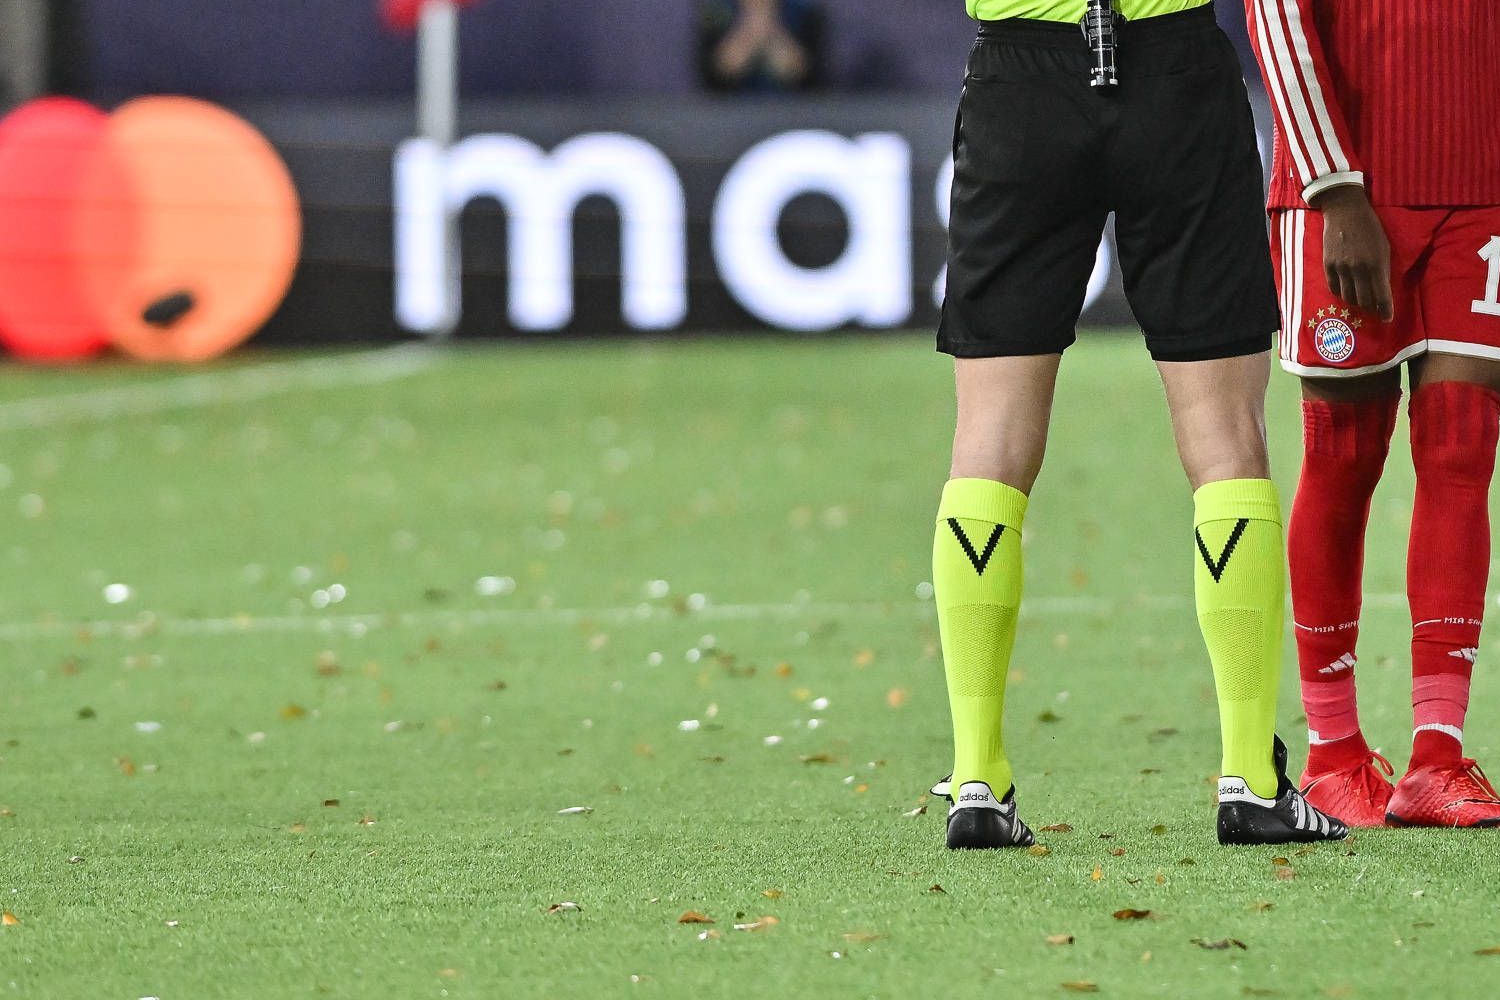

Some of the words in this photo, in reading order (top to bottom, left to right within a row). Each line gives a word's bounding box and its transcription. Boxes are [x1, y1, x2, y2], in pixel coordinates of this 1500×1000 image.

[1323, 320, 1351, 337] BAYERN
[1444, 616, 1465, 625] MIA
[1314, 625, 1335, 633] MIA
[959, 792, 990, 802] adidas
